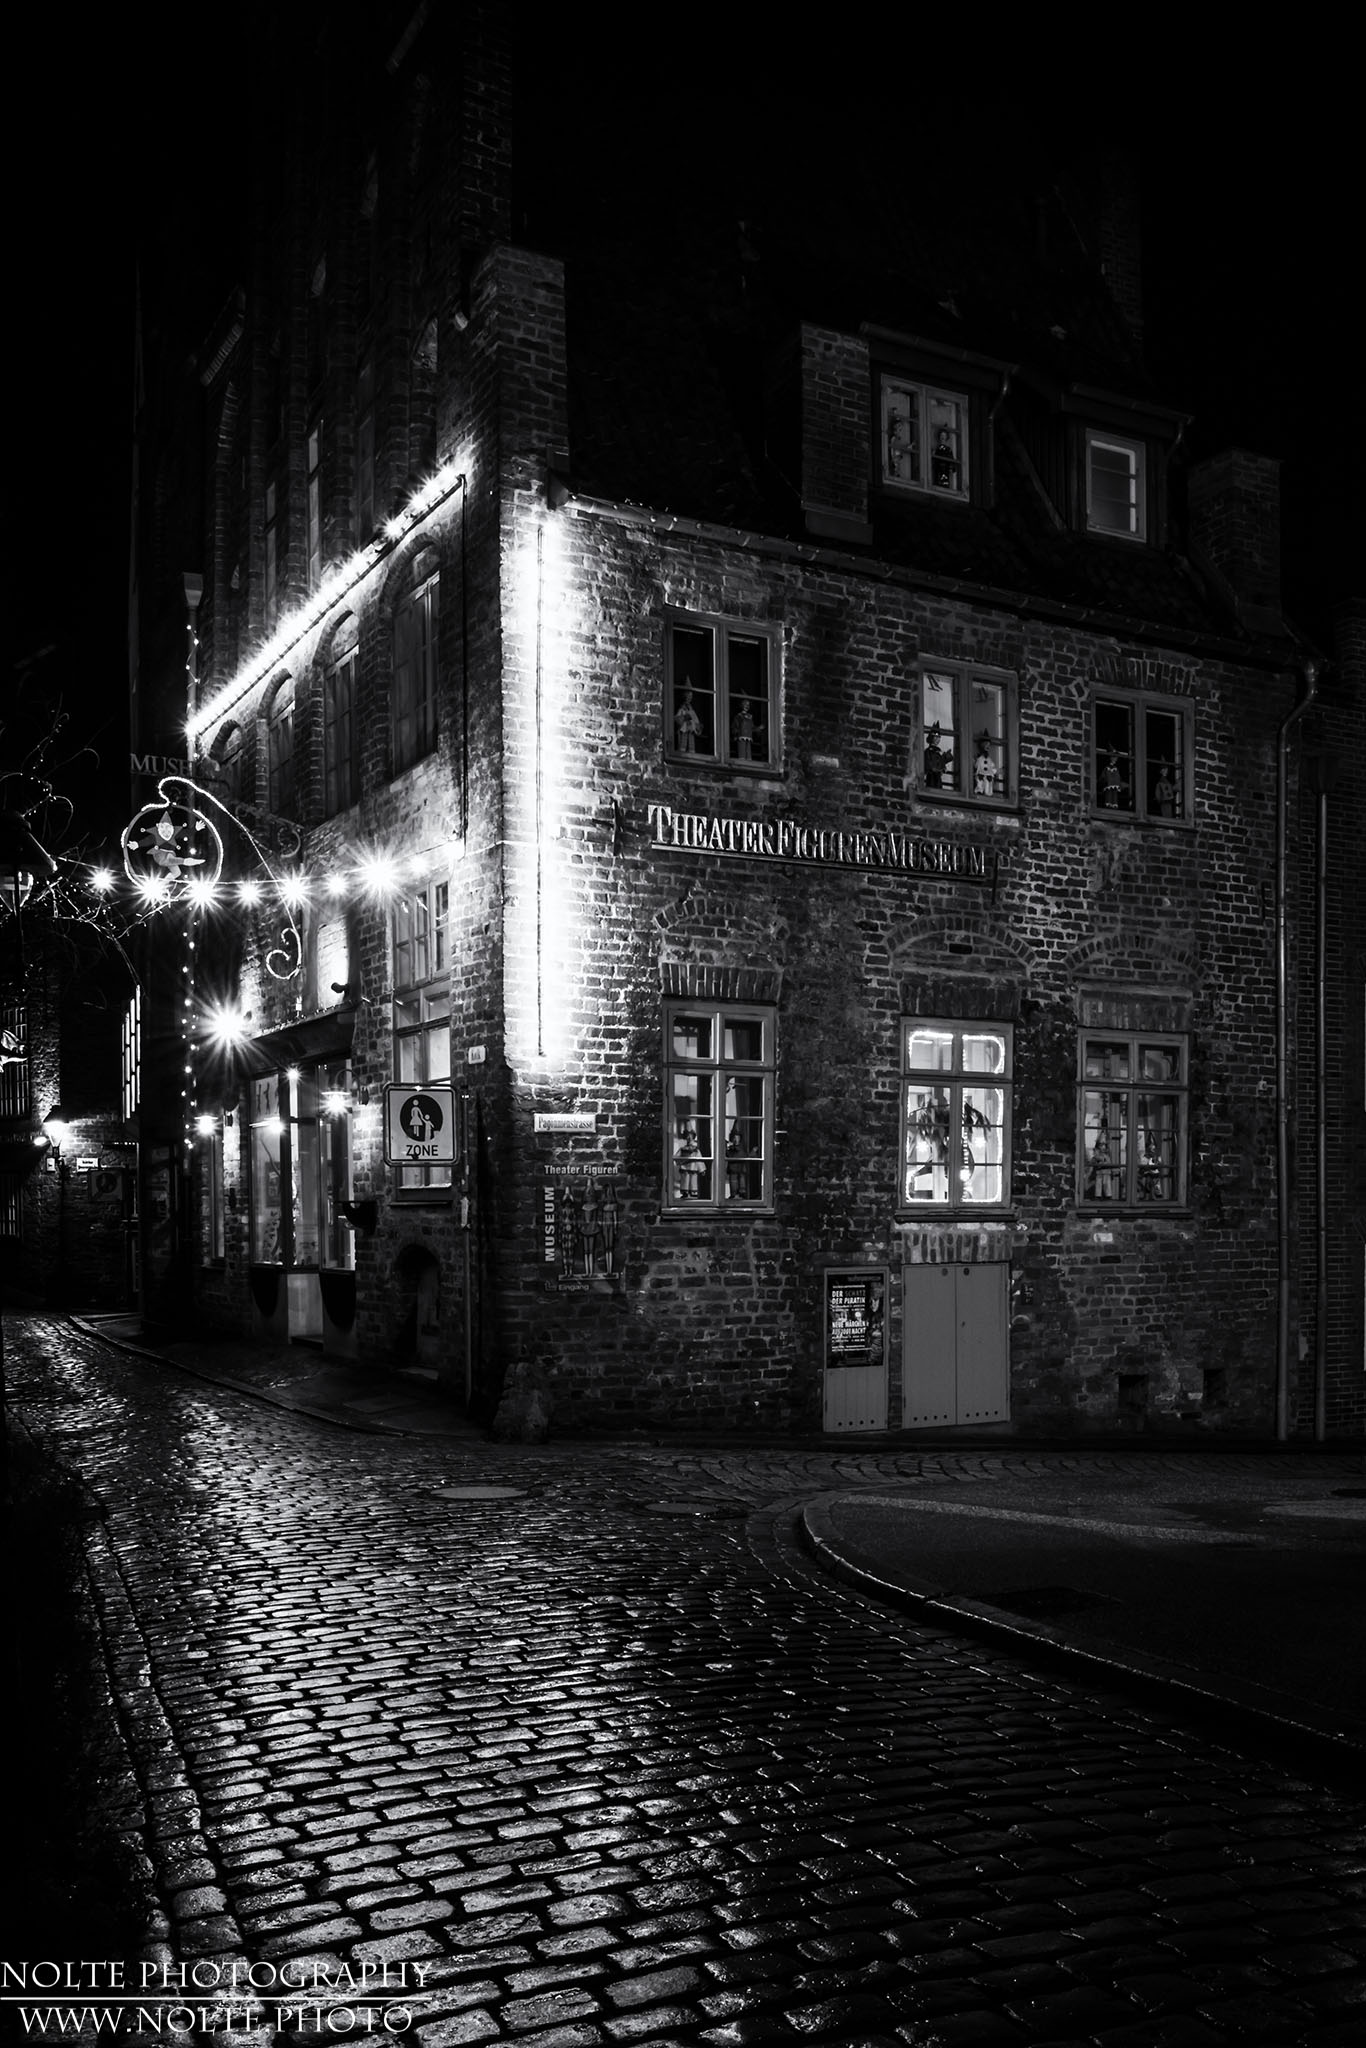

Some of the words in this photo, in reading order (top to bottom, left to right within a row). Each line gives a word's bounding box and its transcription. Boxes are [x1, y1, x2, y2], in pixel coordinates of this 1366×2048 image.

[406, 1145, 439, 1156] ZONE
[544, 1165, 580, 1175] Theater
[583, 1165, 618, 1176] Figuren
[544, 1186, 556, 1262] MUSEUM
